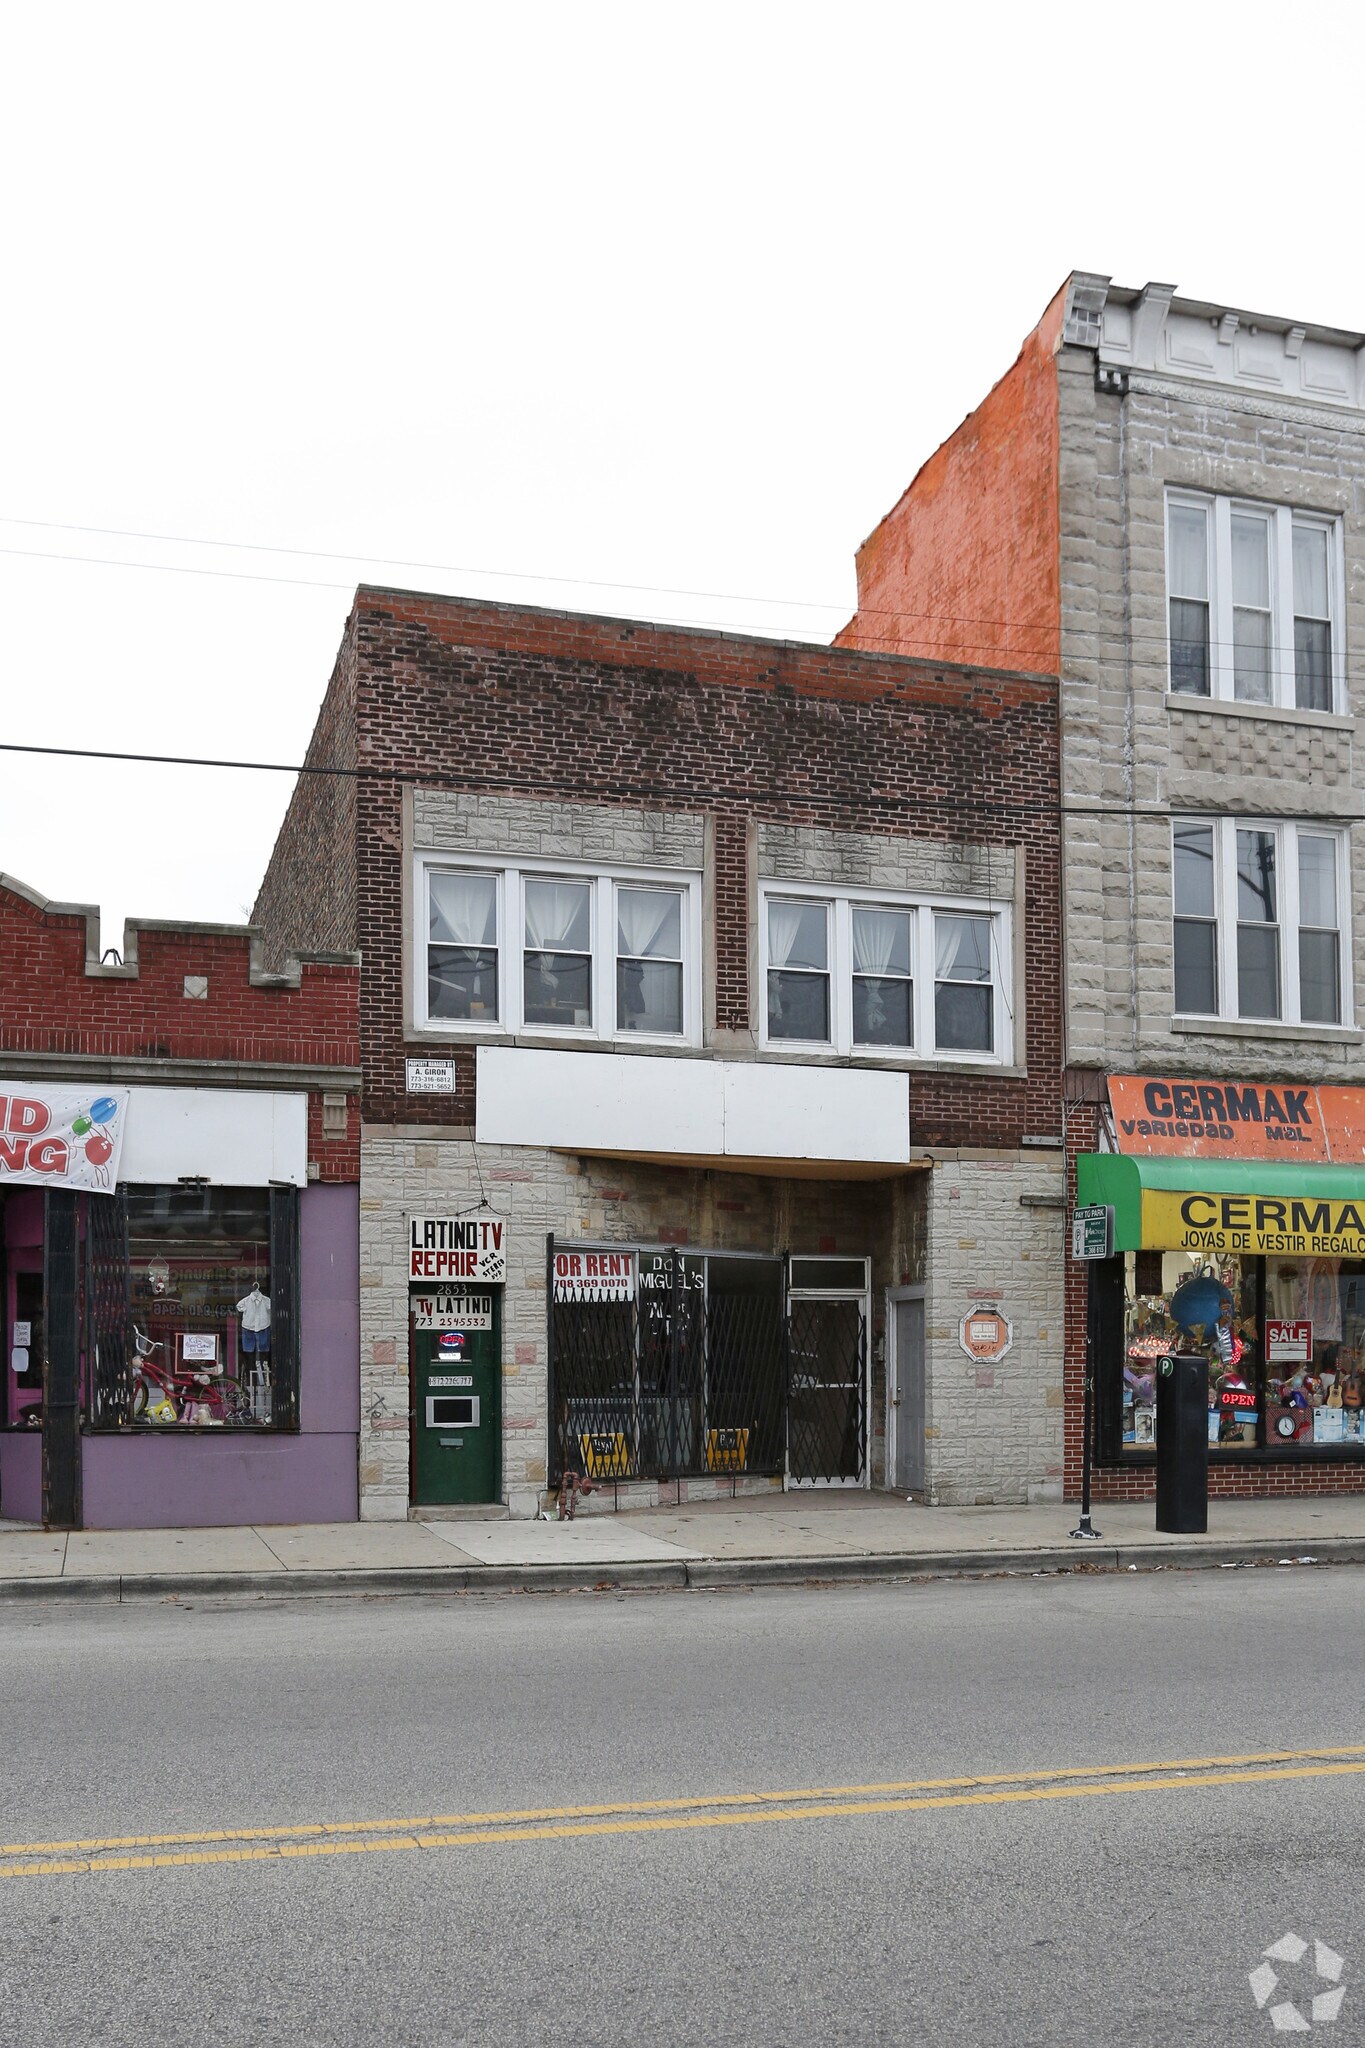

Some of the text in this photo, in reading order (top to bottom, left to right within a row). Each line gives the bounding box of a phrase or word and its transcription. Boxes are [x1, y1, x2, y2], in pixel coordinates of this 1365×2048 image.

[1144, 1082, 1312, 1124] CERMAK
[1075, 1211, 1084, 1219] PAY
[1091, 1208, 1105, 1217] PARK
[1181, 1196, 1365, 1234] CERMA
[412, 1220, 477, 1249] LATINO
[1181, 1231, 1225, 1249] JOYAS
[1232, 1233, 1250, 1249] DE
[1257, 1234, 1305, 1251] VESTIR
[412, 1251, 477, 1276] REPAIR
[479, 1252, 498, 1267] VCR
[482, 1258, 505, 1278] STEREO
[553, 1254, 632, 1276] OR RENT
[437, 1283, 467, 1295] 2853
[554, 1279, 628, 1288] 708 369 0070
[416, 1297, 490, 1316] TV LATINO
[415, 1317, 433, 1327] 773
[439, 1335, 464, 1345] OPEN
[1269, 1328, 1307, 1342] SALE
[1221, 1393, 1256, 1406] OPEN
